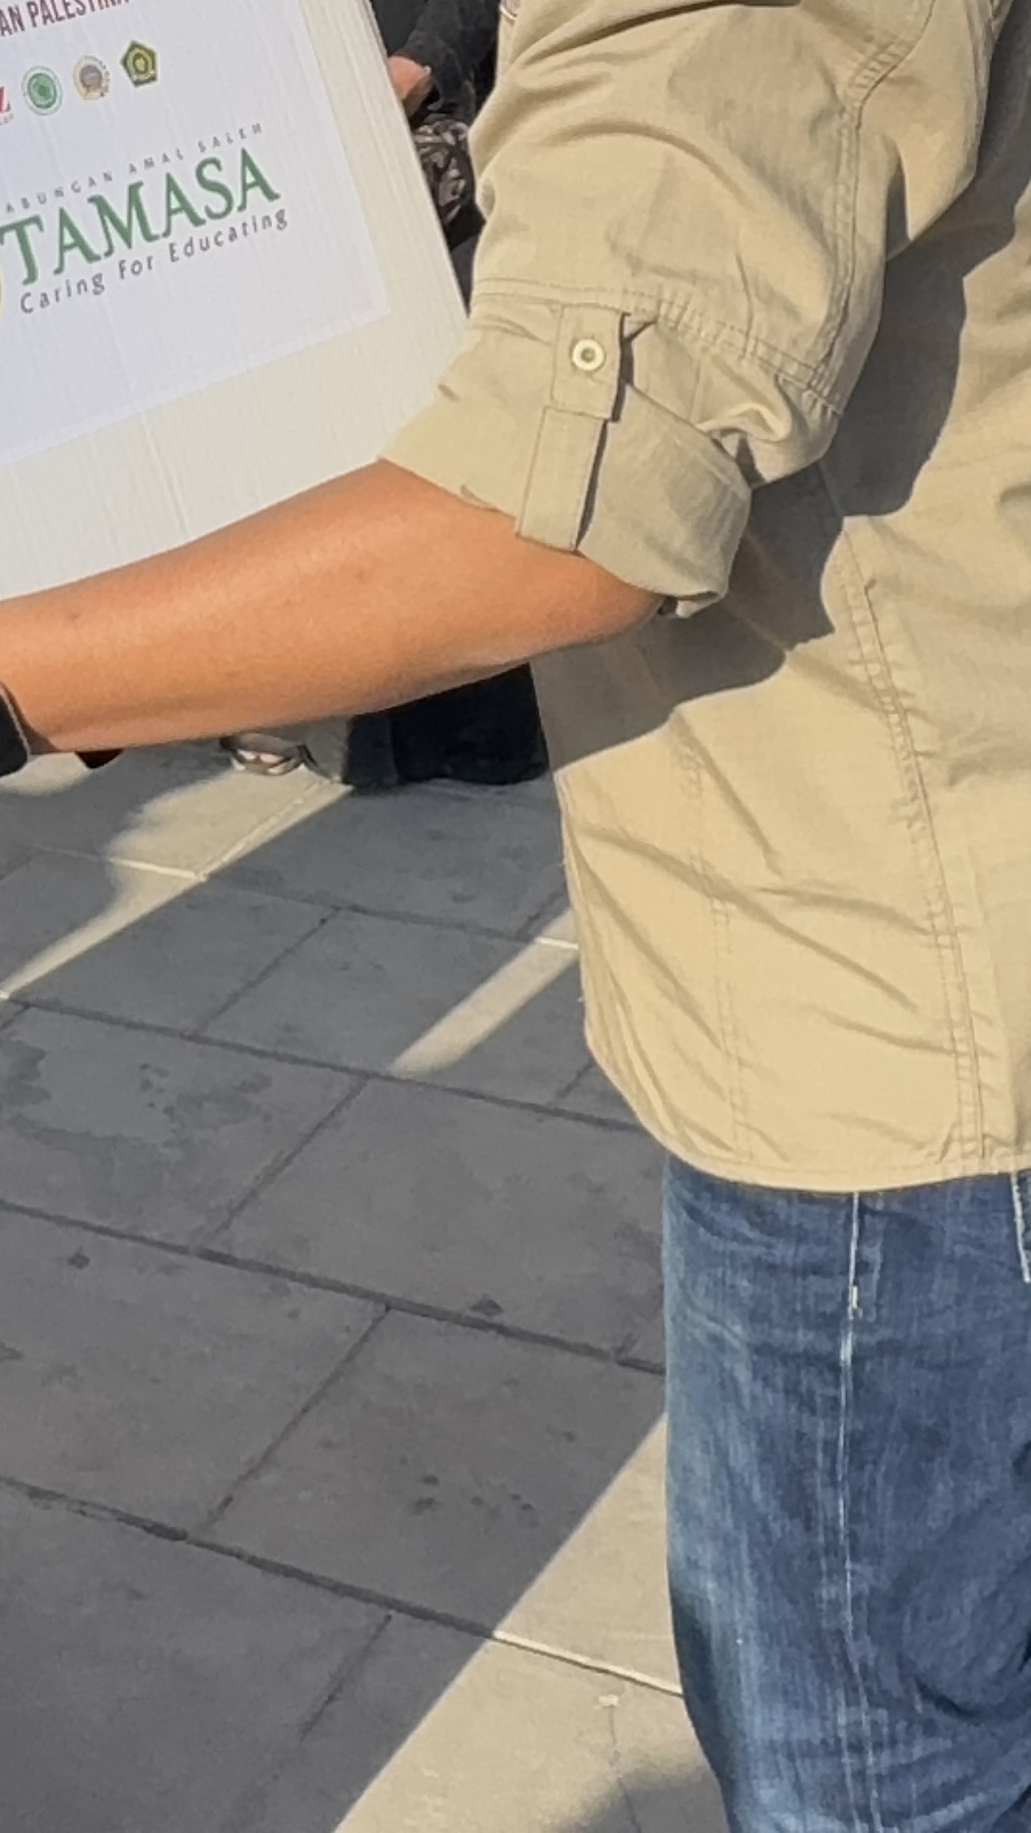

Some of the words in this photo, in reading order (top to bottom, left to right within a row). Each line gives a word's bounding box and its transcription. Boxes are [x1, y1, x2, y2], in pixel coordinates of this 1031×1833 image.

[19, 271, 106, 315] Caring
[117, 253, 155, 281] For
[168, 207, 289, 264] Educating
